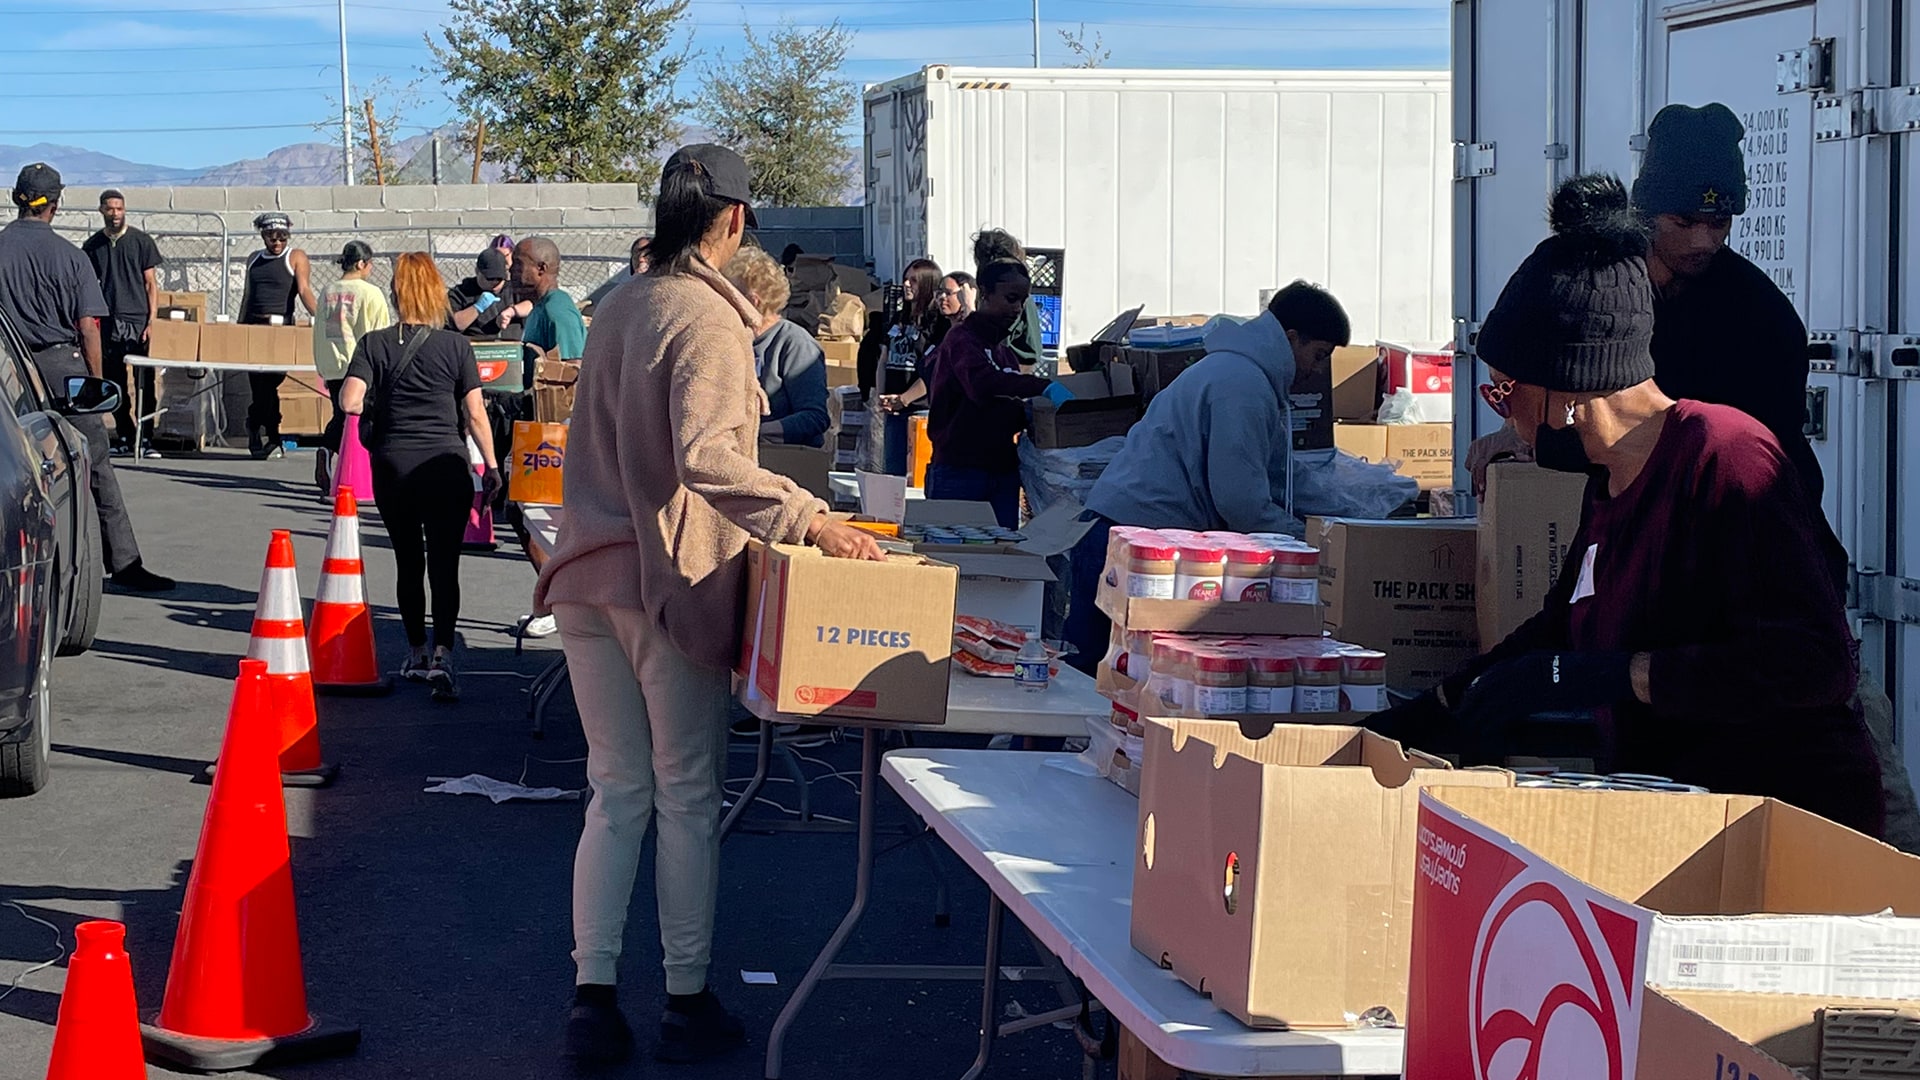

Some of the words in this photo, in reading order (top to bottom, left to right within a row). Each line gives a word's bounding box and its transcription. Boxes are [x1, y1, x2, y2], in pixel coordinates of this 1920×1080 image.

[1777, 107, 1789, 129] KG
[1777, 132, 1788, 154] LB
[1776, 161, 1787, 183] KG
[1775, 186, 1786, 207] LB
[1775, 215, 1786, 236] KG
[1774, 239, 1784, 260] LB
[1402, 449, 1416, 457] THE
[1418, 449, 1438, 457] PACK
[1373, 581, 1402, 599] THE
[1407, 582, 1449, 599] PACK
[817, 626, 840, 644] 12
[847, 628, 911, 649] PIECES
